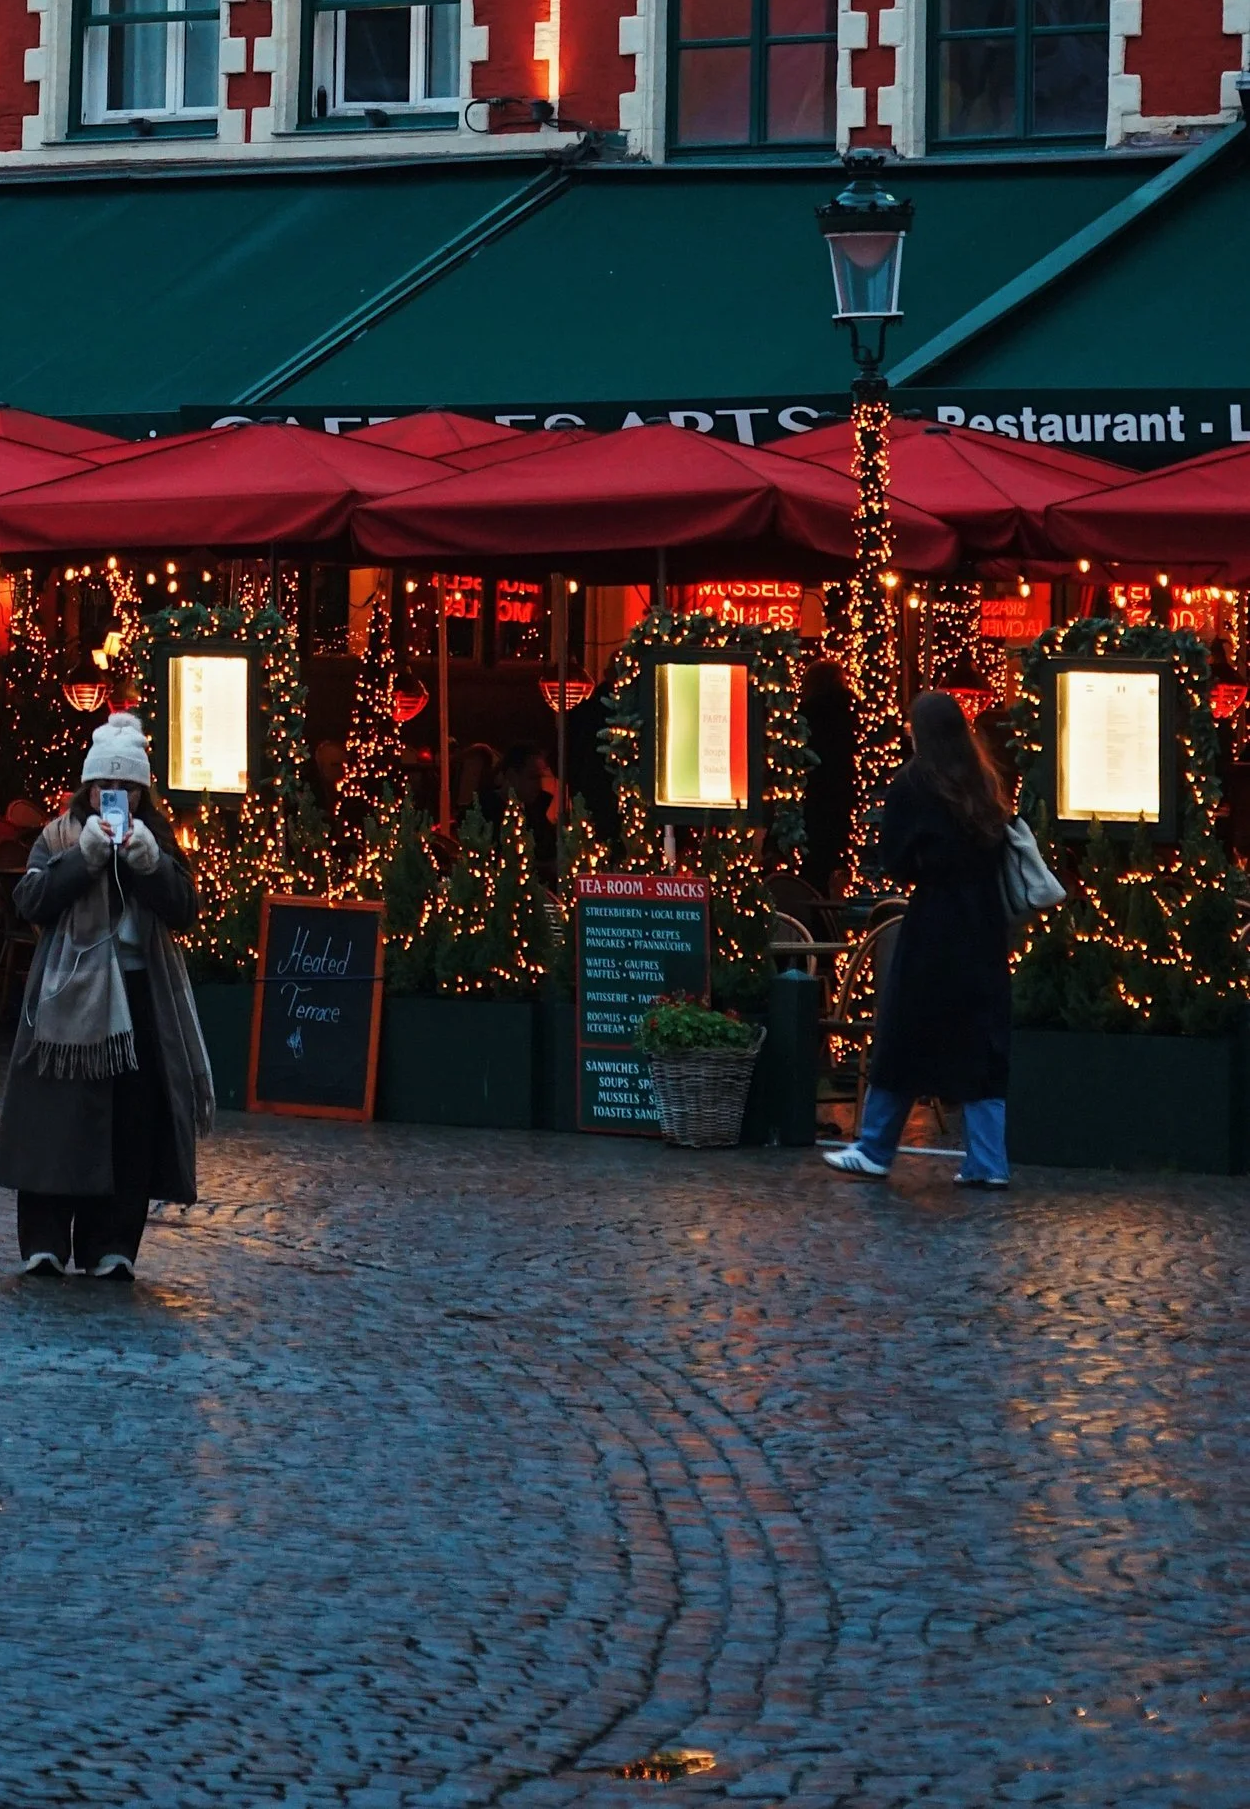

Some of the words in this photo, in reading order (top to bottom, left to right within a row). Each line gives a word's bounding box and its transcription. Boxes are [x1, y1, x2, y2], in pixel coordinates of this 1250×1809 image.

[578, 879, 644, 895] TEA-ROOM
[656, 882, 704, 898] SNACKS
[585, 906, 642, 918] STREEKBIEREN
[651, 910, 674, 920] LOCAL
[676, 911, 700, 920] BEERS
[586, 927, 643, 938] PANNEKOEKEN
[277, 926, 352, 974] Heated
[586, 938, 626, 949] PANCAKES
[586, 958, 616, 968] WAFELS
[624, 960, 659, 970] GAUFRES
[586, 968, 620, 980] WAFFELS
[629, 970, 664, 982] WAFFELN
[280, 982, 340, 1023] Terrace
[586, 992, 629, 1003] PATISSERIE
[587, 1024, 624, 1034] ICECREAM
[586, 1060, 640, 1074] SANWICHES
[598, 1076, 629, 1088] SOUPS
[598, 1090, 640, 1104] MUSSELS
[593, 1106, 632, 1118] TOASTES
